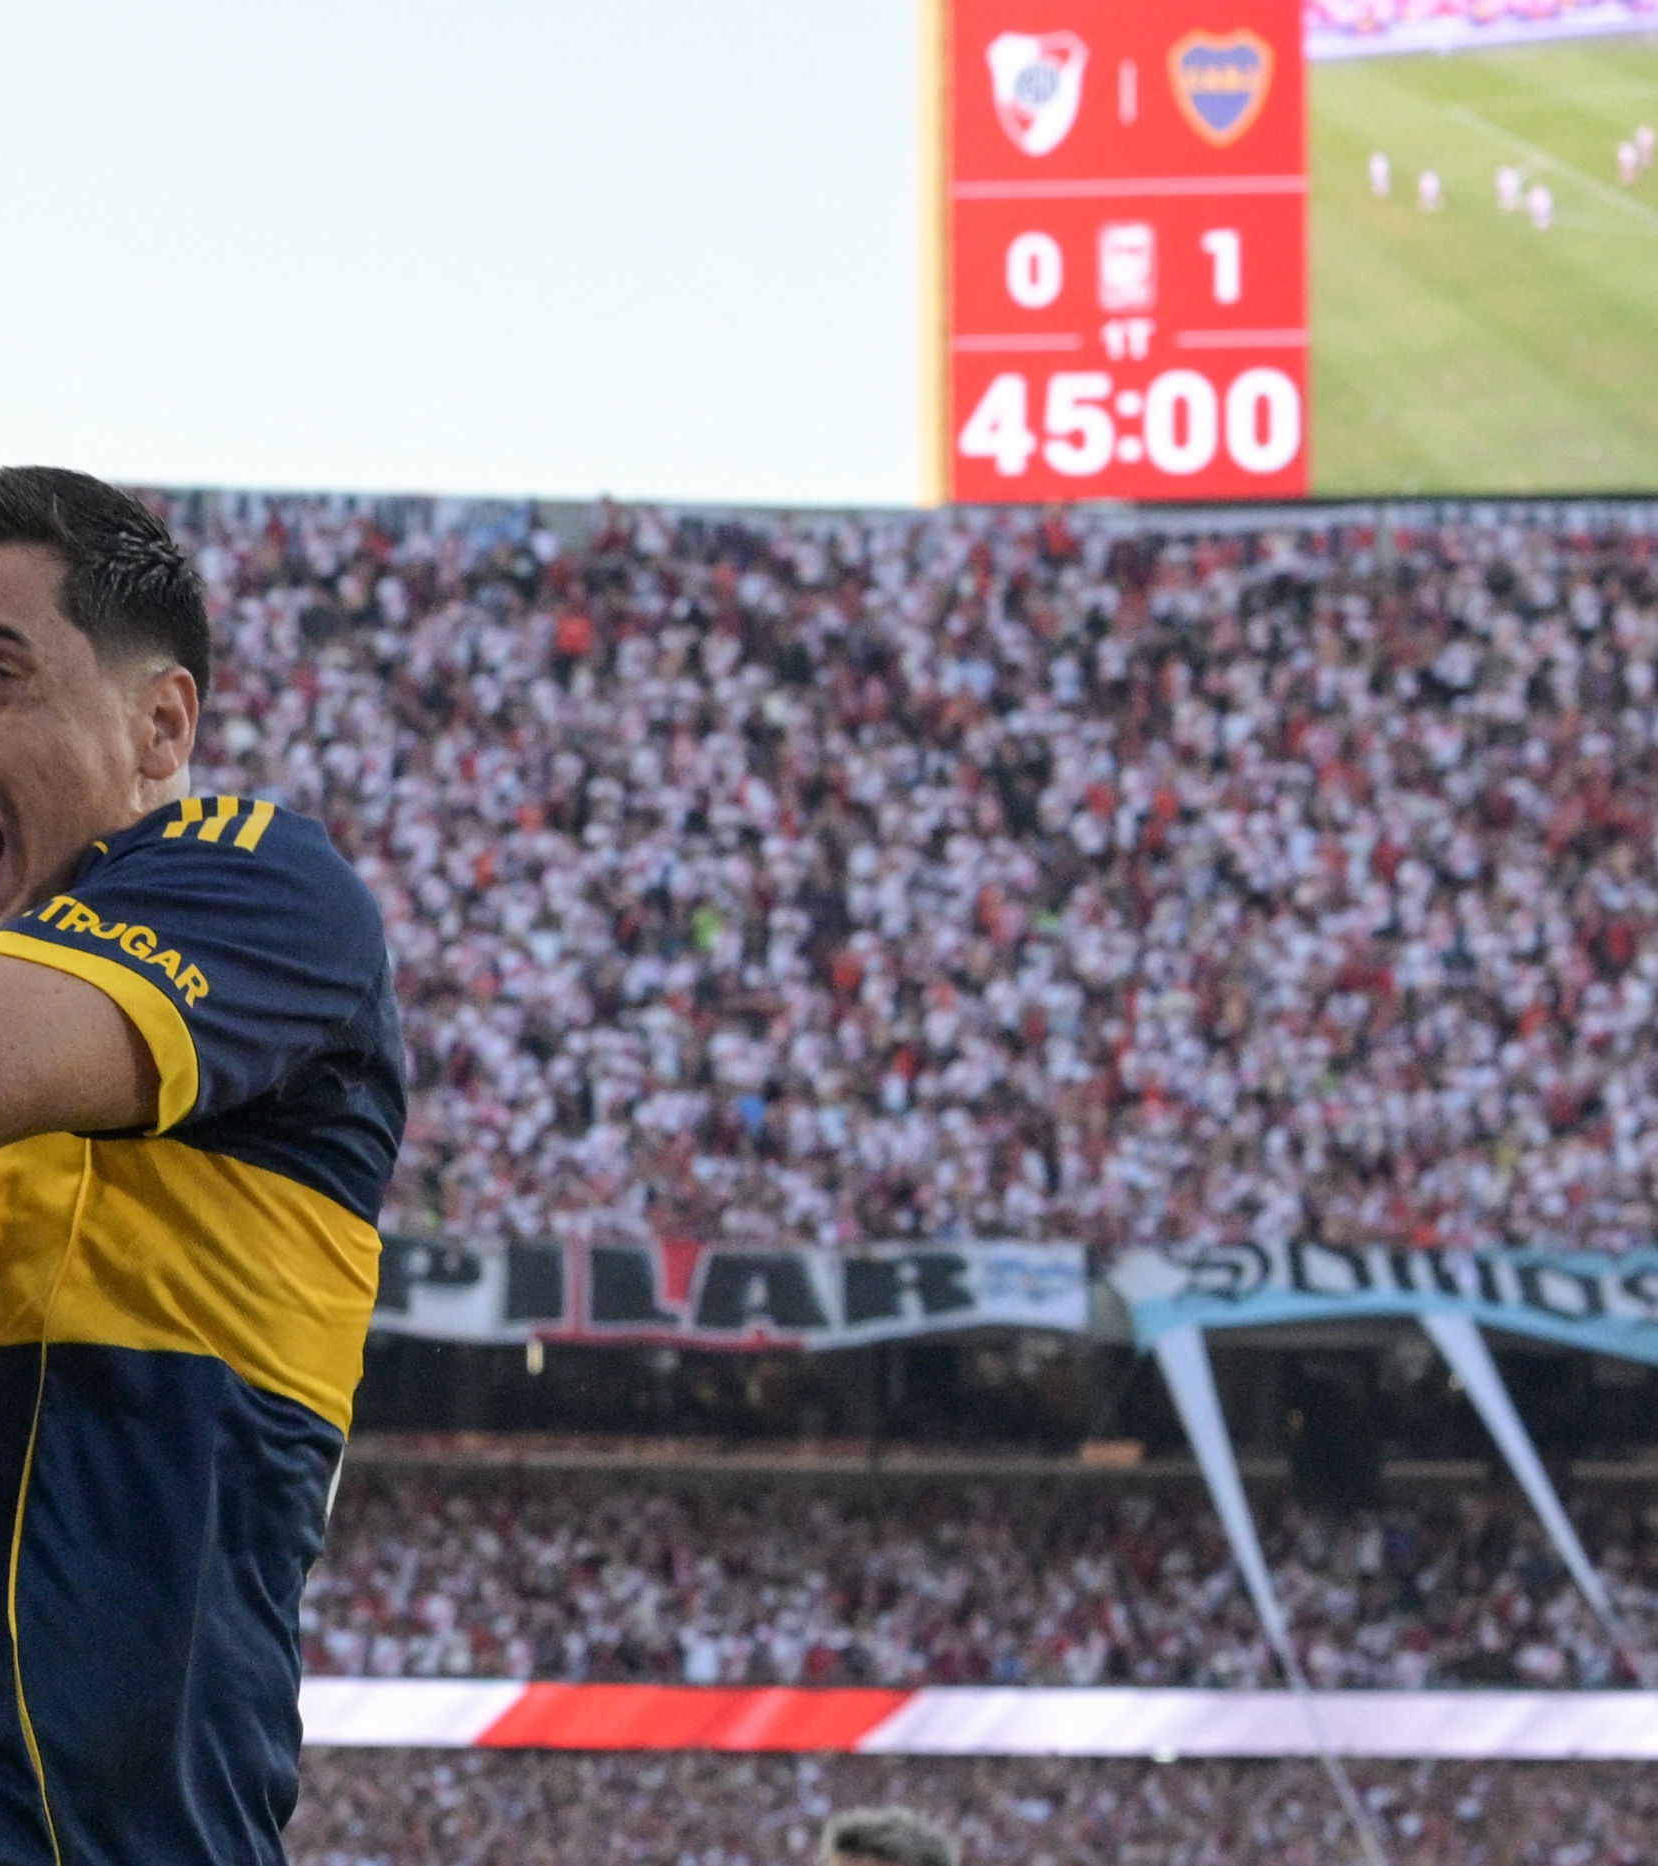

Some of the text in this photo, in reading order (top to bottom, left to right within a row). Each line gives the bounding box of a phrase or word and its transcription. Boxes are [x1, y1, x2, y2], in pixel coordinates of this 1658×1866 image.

[1005, 228, 1242, 309] 0 1
[957, 367, 1301, 476] 45:00
[22, 895, 209, 1008] TRUGAR
[375, 1240, 977, 1328] PILAR
